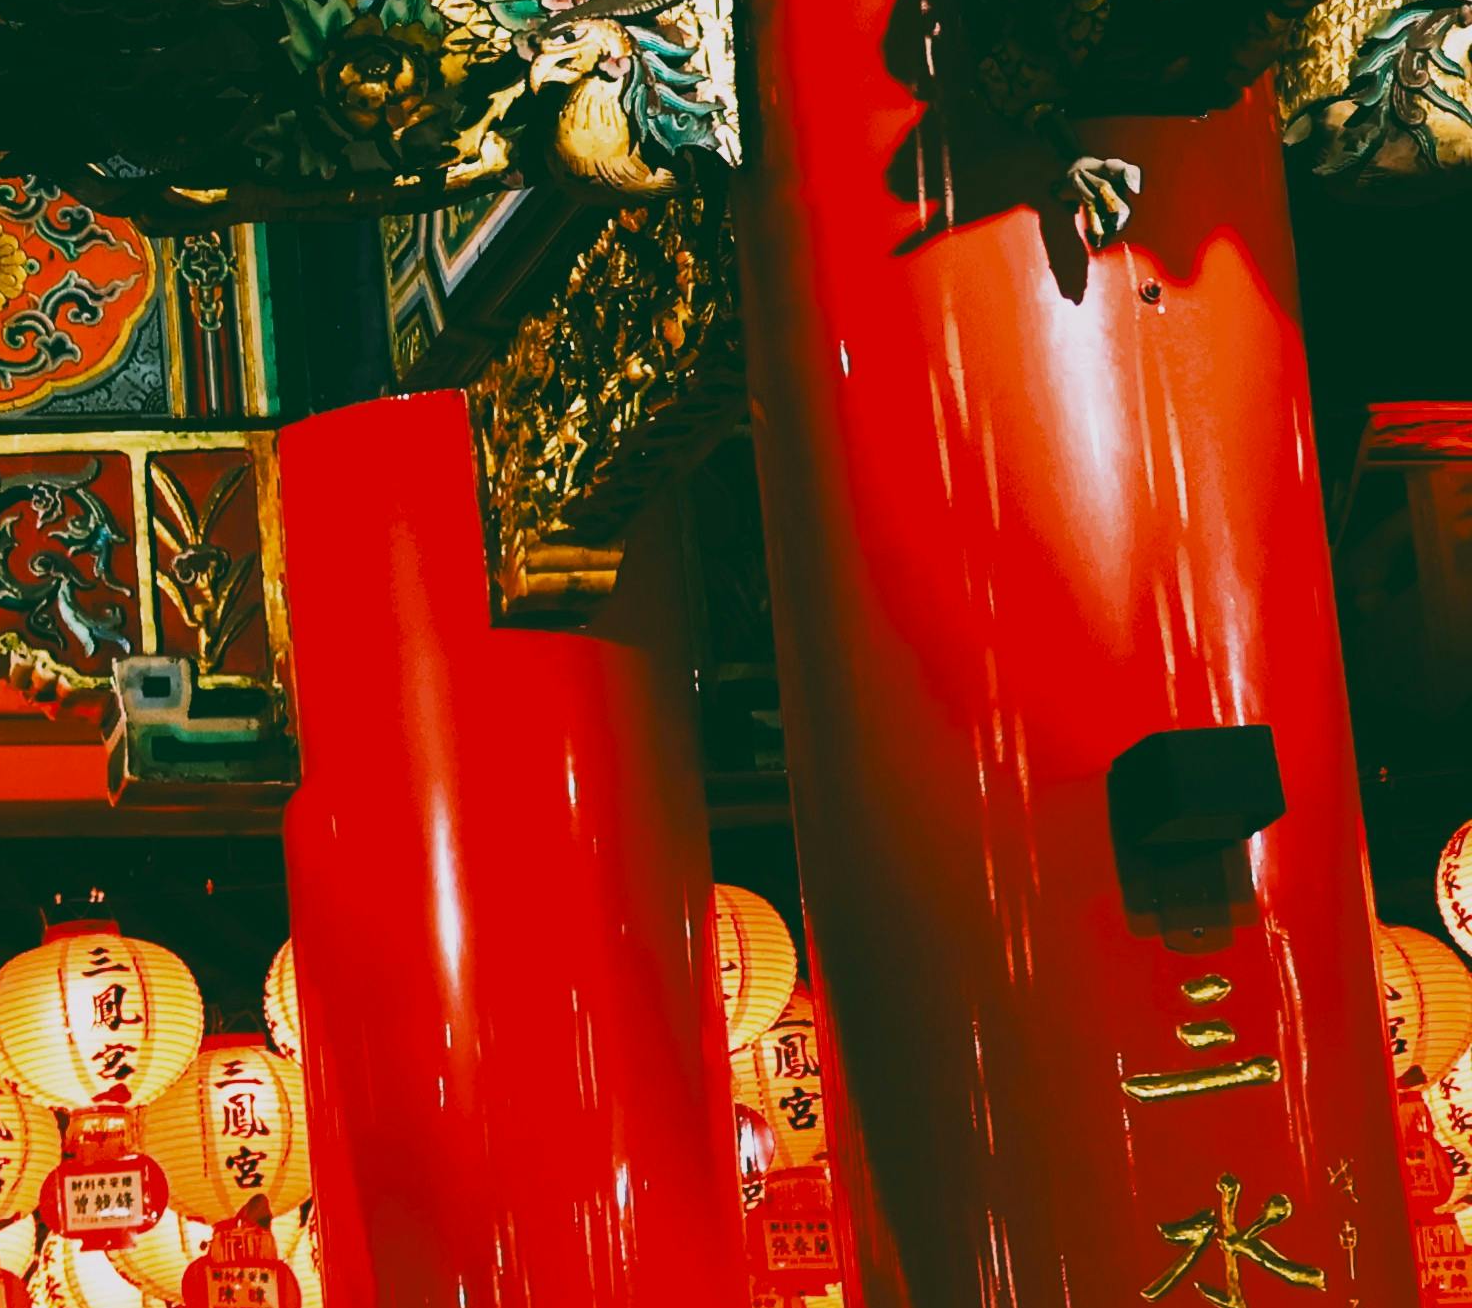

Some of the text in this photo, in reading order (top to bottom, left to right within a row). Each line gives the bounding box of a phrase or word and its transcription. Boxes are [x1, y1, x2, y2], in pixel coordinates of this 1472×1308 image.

[81, 947, 143, 1078] 三鳳宮
[214, 1061, 271, 1189] 三鳳宮
